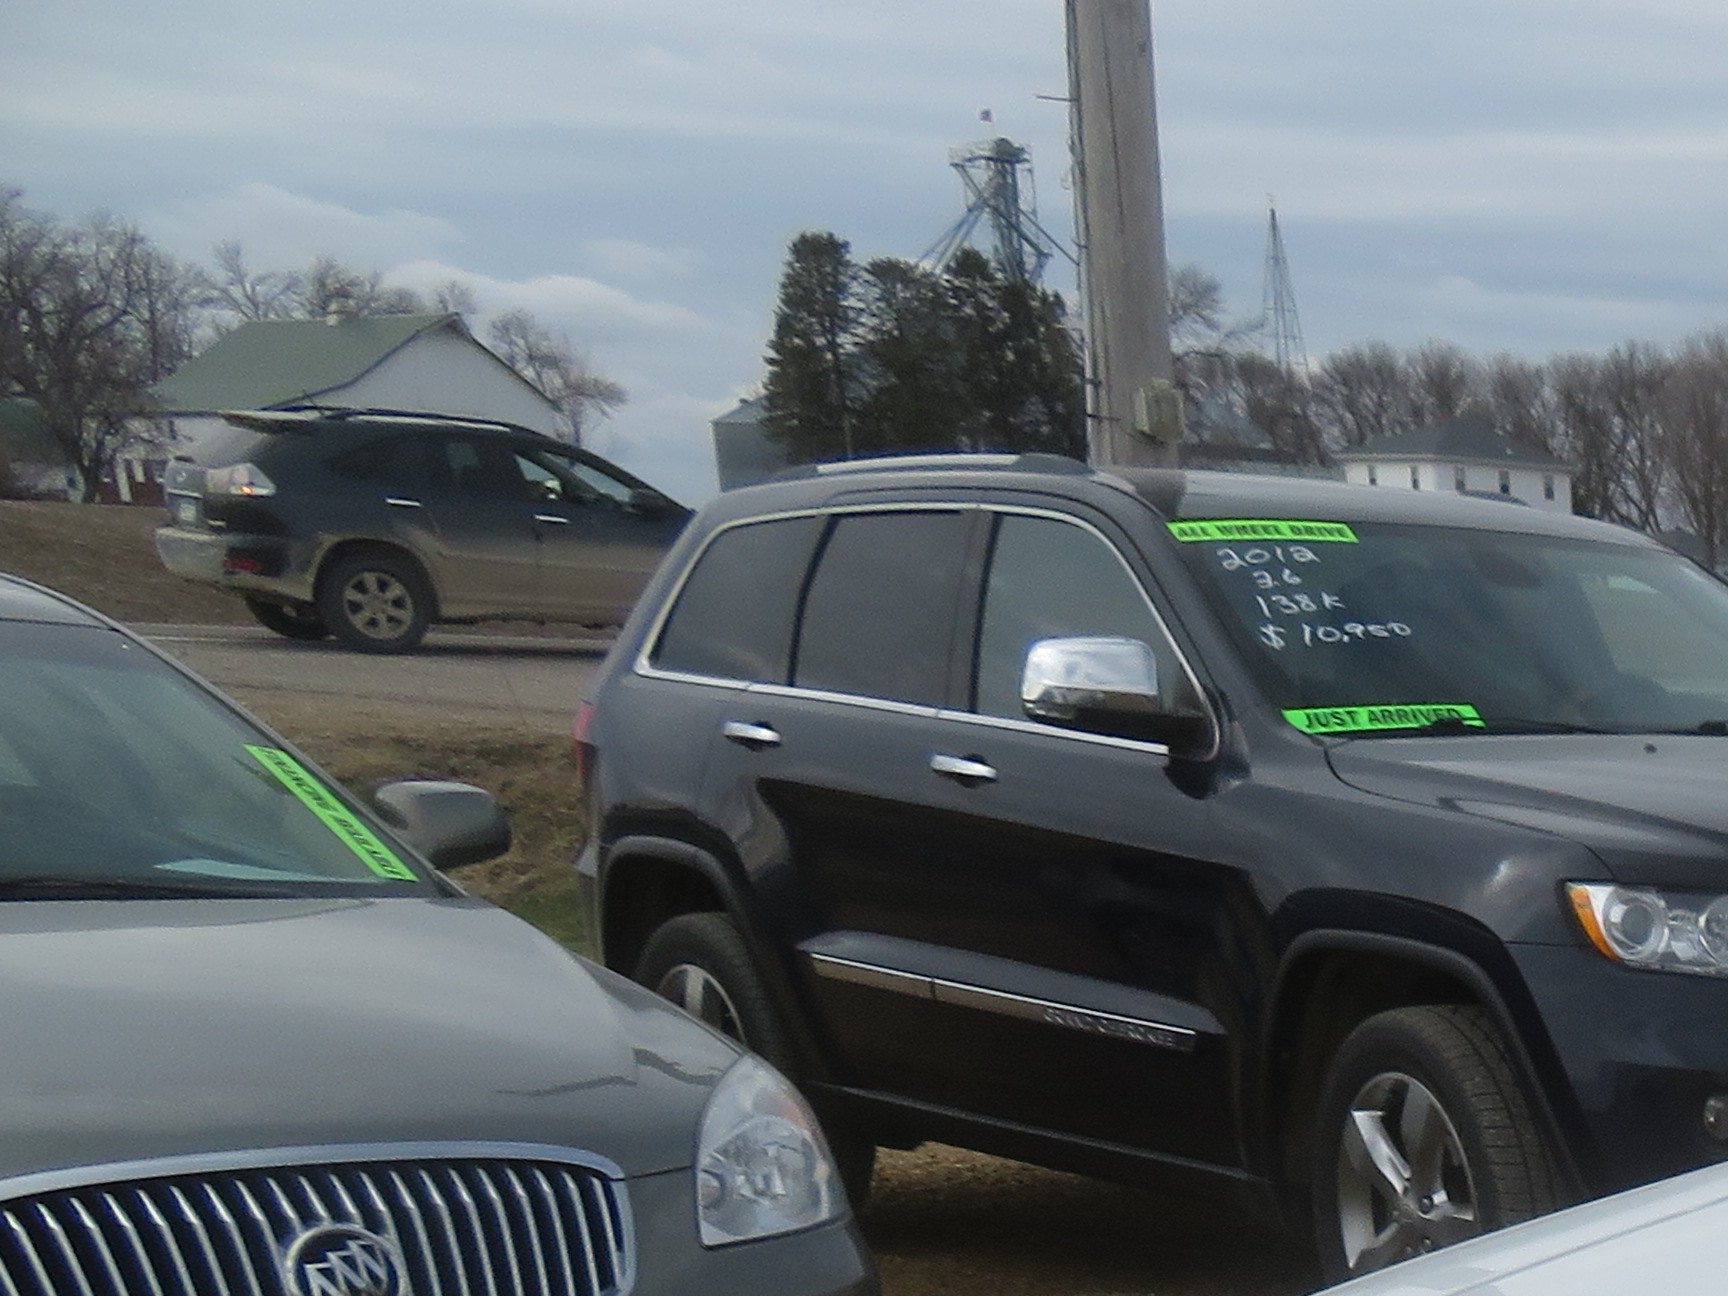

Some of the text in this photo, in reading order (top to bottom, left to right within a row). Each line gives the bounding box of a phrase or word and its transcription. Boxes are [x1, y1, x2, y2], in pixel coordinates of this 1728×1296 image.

[1177, 524, 1350, 539] ALL WHEEL DRIVE
[1216, 545, 1322, 571] 2012
[1304, 707, 1461, 728] JUST ARRIVED
